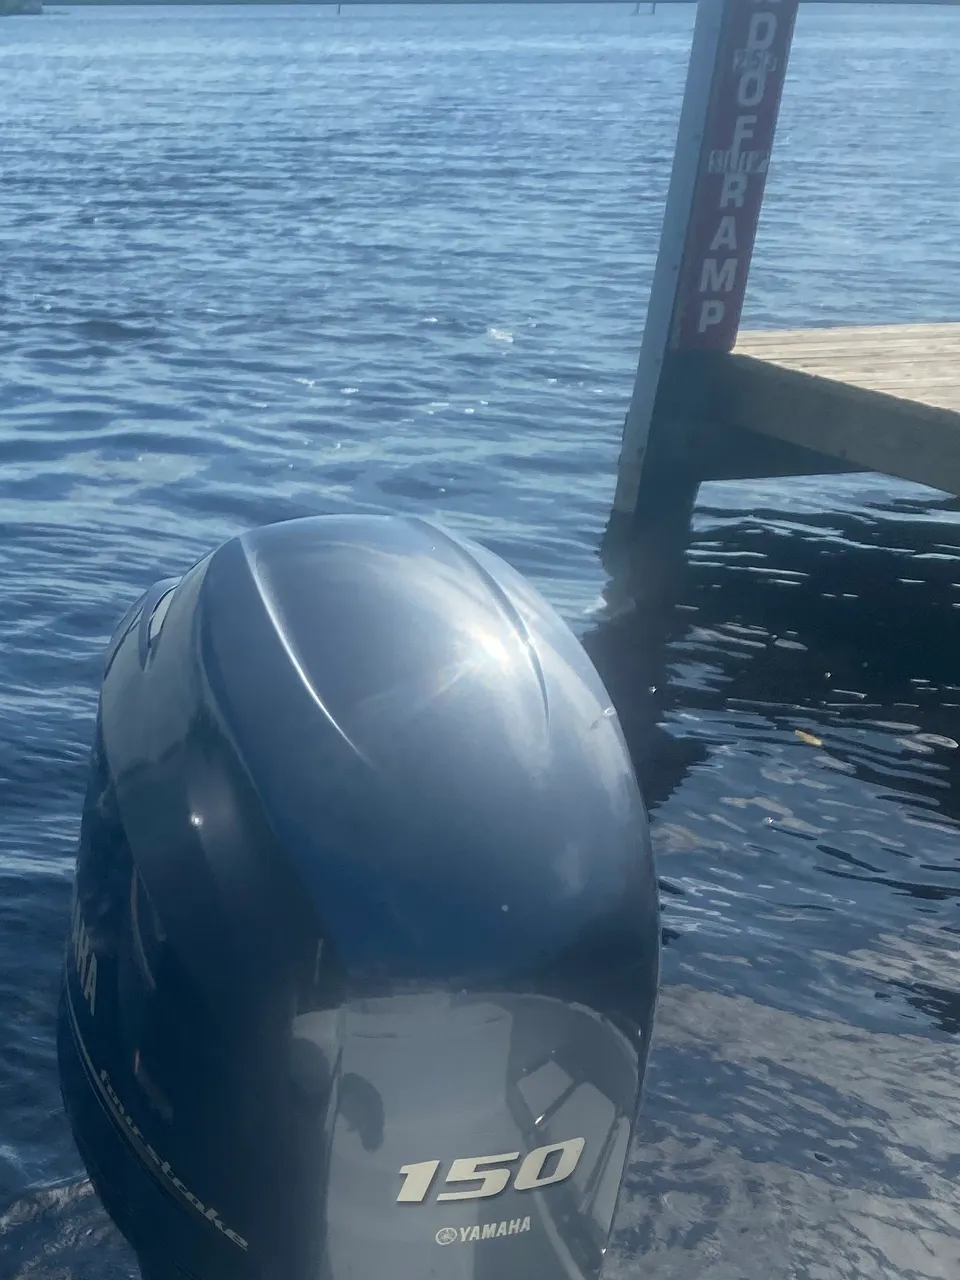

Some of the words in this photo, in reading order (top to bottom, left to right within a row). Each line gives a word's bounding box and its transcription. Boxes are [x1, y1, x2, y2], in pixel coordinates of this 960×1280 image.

[697, 172, 748, 334] RAMP
[395, 1136, 586, 1203] 150
[459, 1215, 532, 1243] YAMAHA
